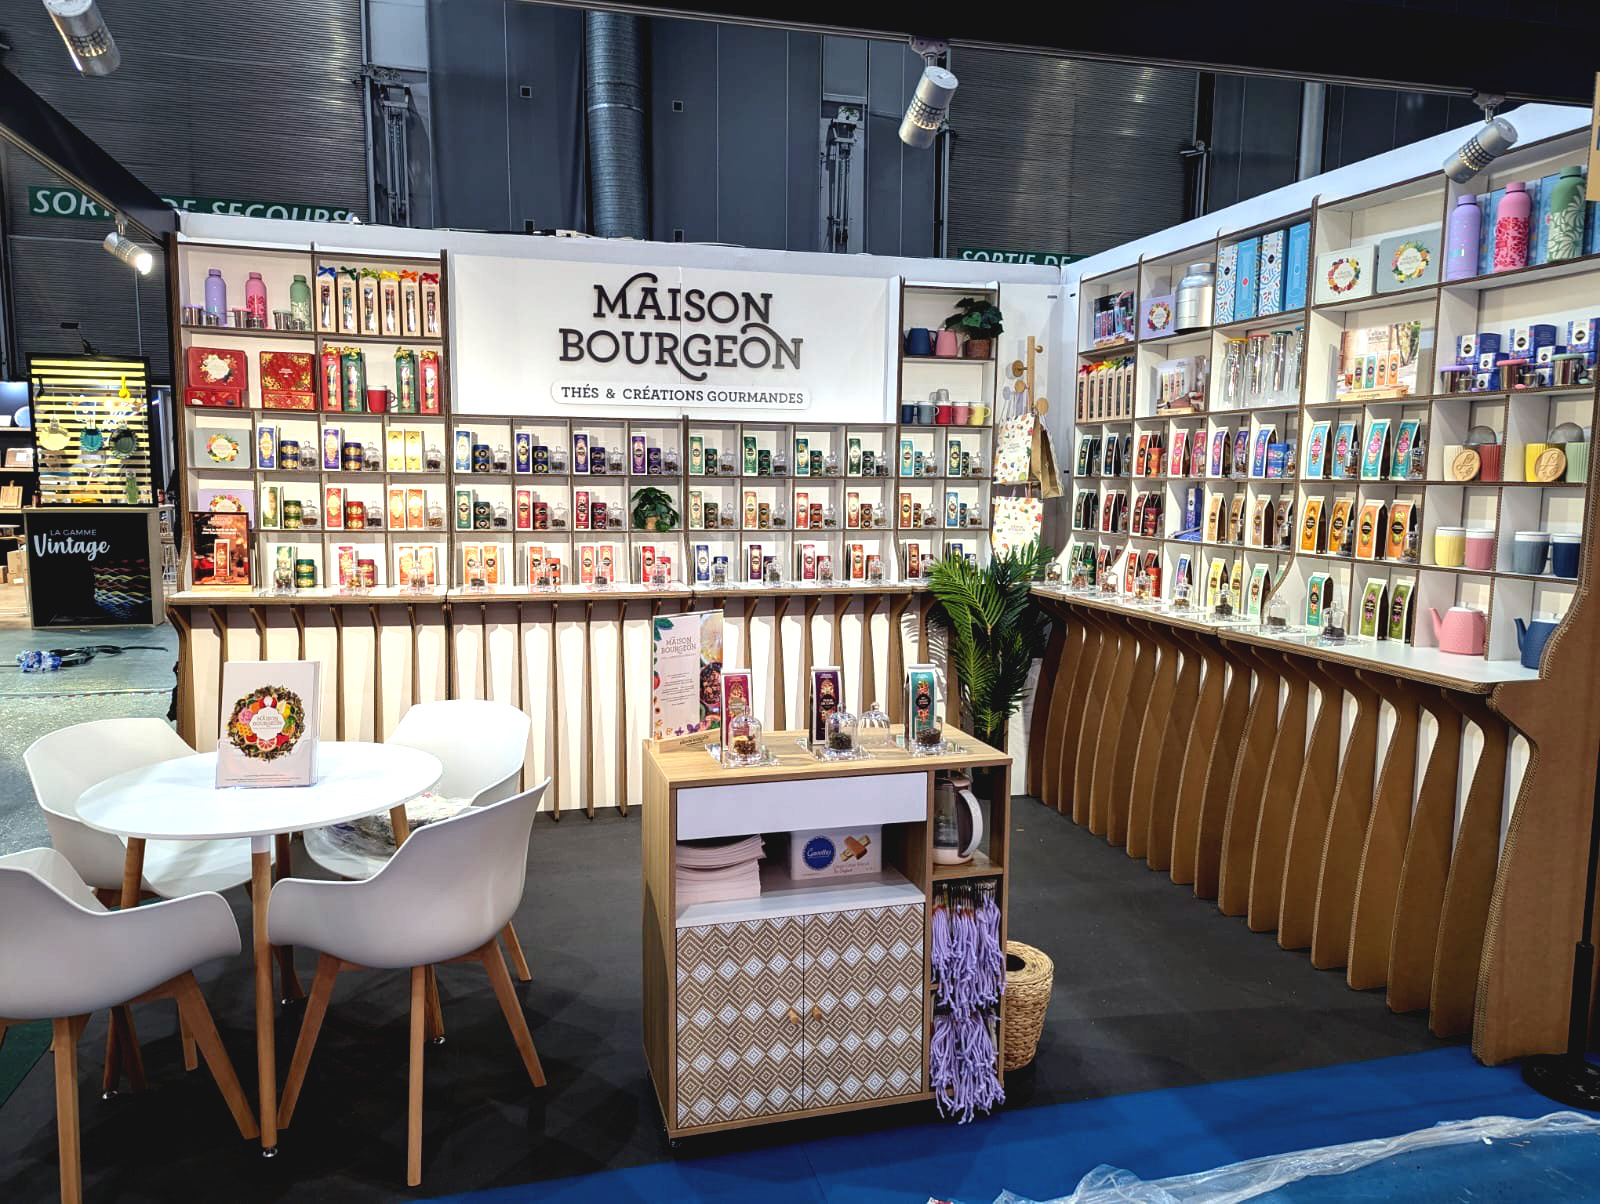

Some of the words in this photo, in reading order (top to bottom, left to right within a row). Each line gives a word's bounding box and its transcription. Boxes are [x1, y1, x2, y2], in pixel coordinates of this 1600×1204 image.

[593, 272, 773, 324] MAISON
[559, 323, 804, 381] BOURGEON
[561, 384, 599, 399] THÉS
[606, 388, 616, 399] &
[623, 386, 704, 402] CRÉATIONS
[707, 390, 804, 404] GOURMANDES
[33, 533, 110, 561] Vintage
